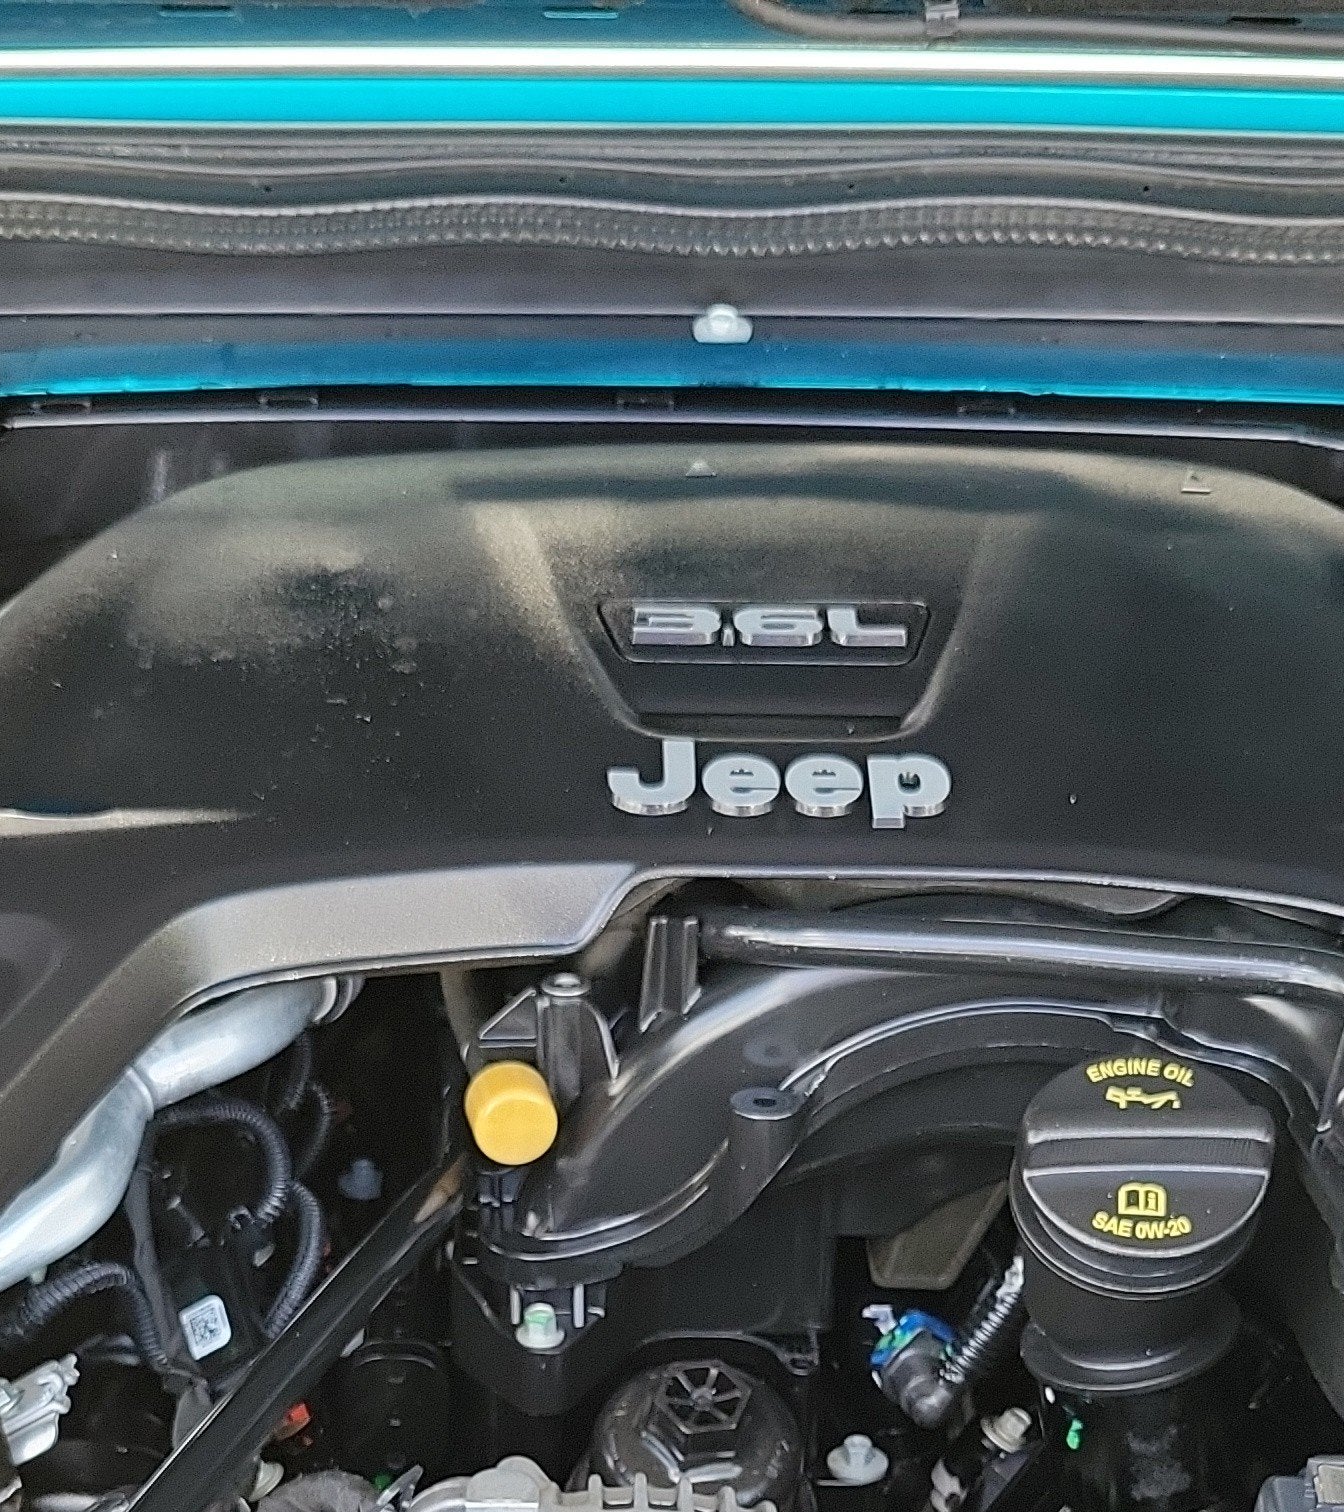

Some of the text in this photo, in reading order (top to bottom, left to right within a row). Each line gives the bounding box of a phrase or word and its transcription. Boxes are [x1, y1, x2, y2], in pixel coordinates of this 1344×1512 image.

[632, 604, 908, 647] 3.6L
[607, 738, 952, 829] Jeep
[1086, 1058, 1196, 1087] ENGINE OIL
[1091, 1210, 1193, 1240] SAE 0W-20
